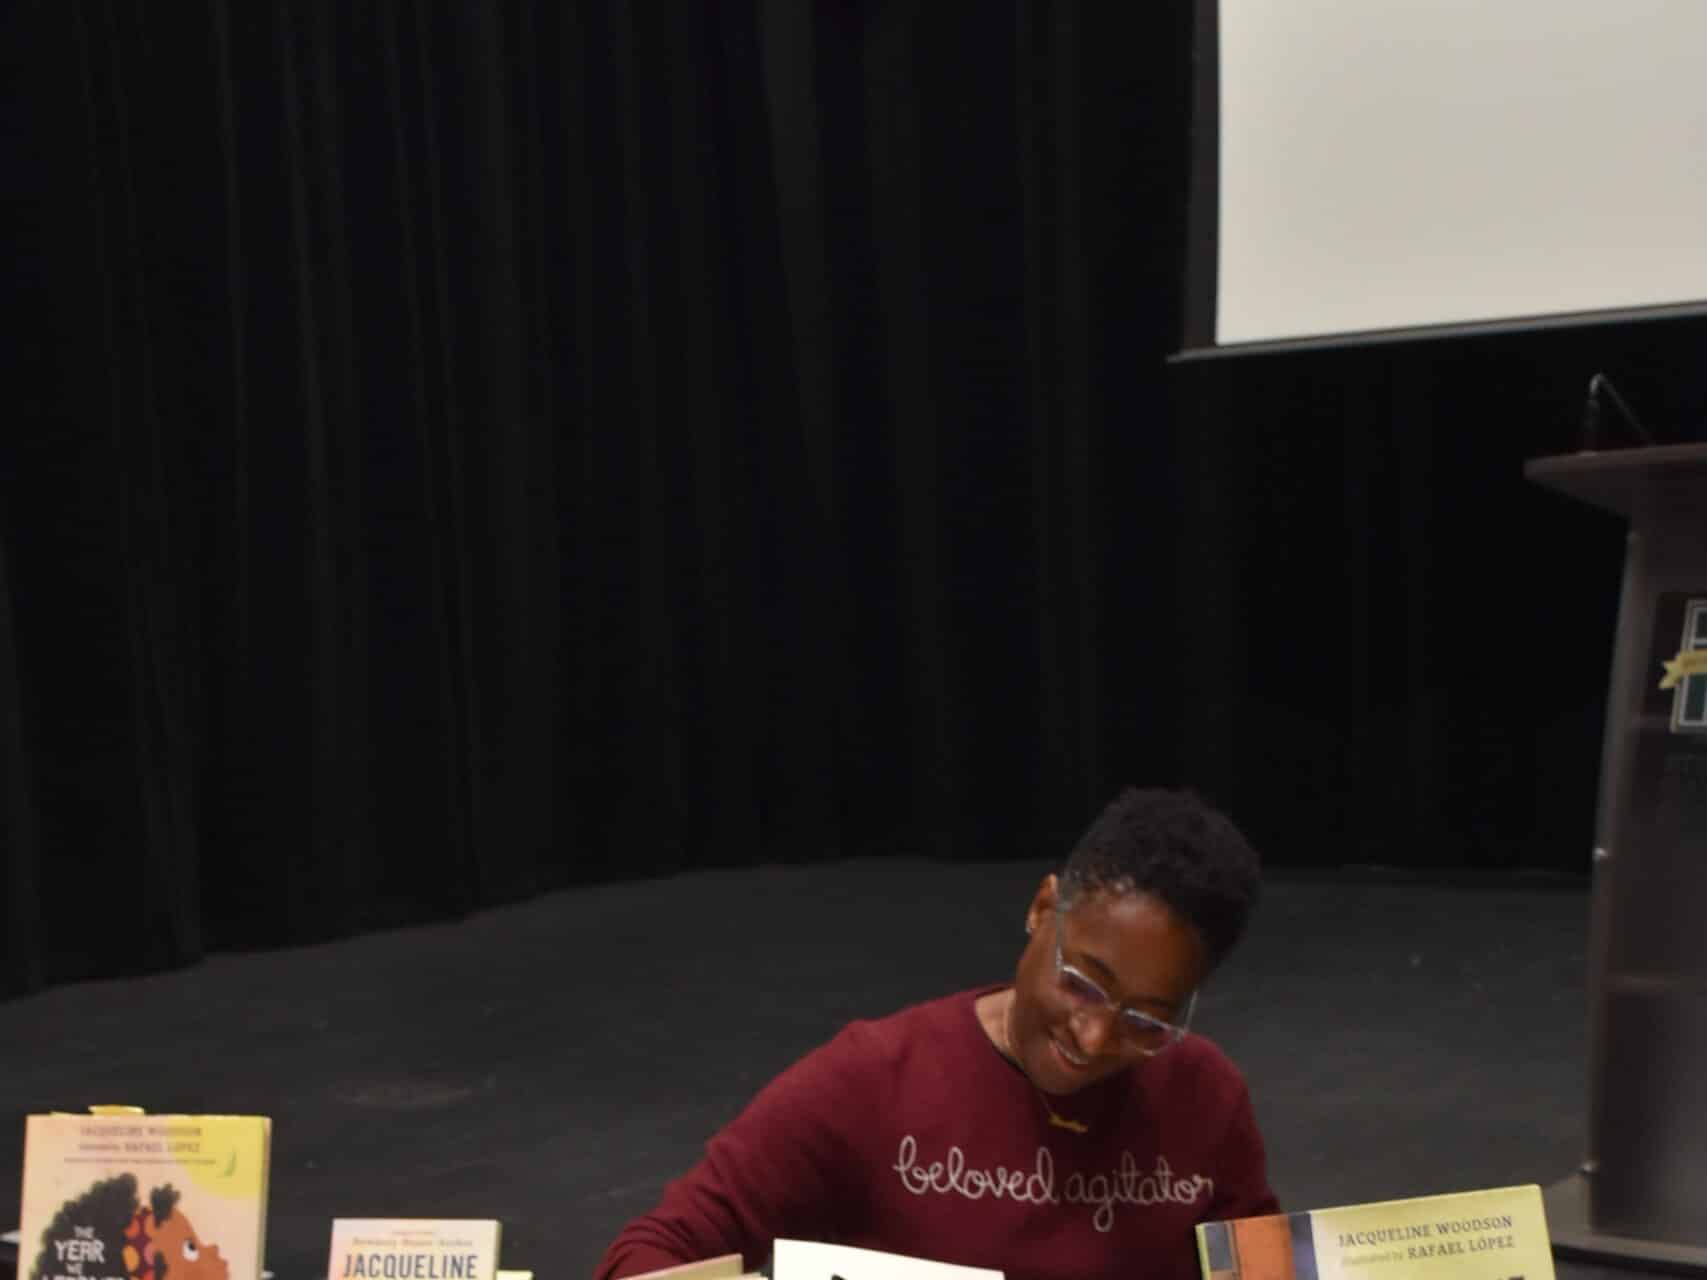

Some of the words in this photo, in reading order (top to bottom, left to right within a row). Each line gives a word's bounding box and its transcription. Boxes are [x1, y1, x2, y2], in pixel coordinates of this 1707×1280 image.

[894, 1135, 1057, 1204] beloved
[1063, 1152, 1214, 1232] agitator
[1338, 1223, 1431, 1248] JACQUELINE
[1436, 1215, 1513, 1235] WOODSON
[1408, 1240, 1466, 1260] RAFAEL
[343, 1254, 478, 1280] JACQUELINE
